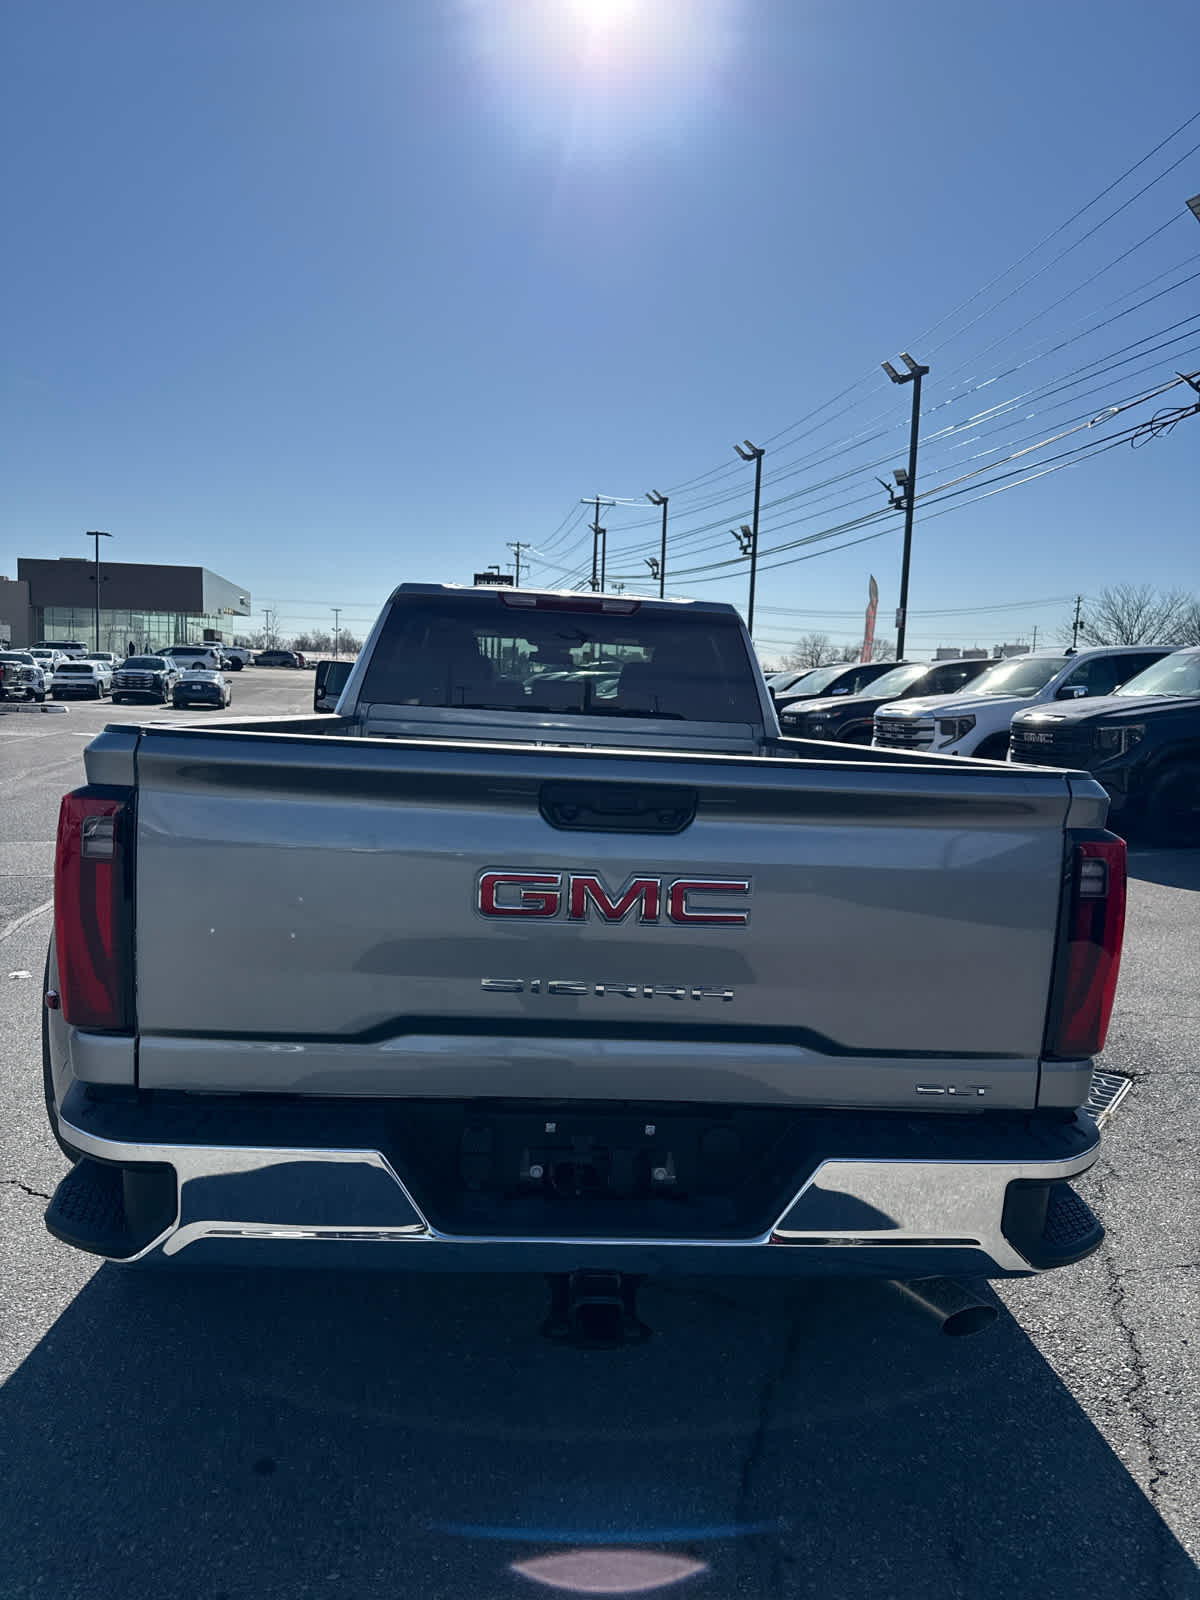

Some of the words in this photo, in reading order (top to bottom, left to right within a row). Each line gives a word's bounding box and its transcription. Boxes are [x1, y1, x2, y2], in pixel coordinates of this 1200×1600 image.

[475, 867, 751, 926] GMC
[480, 977, 735, 1001] SIERRA
[916, 1083, 991, 1097] SLT
